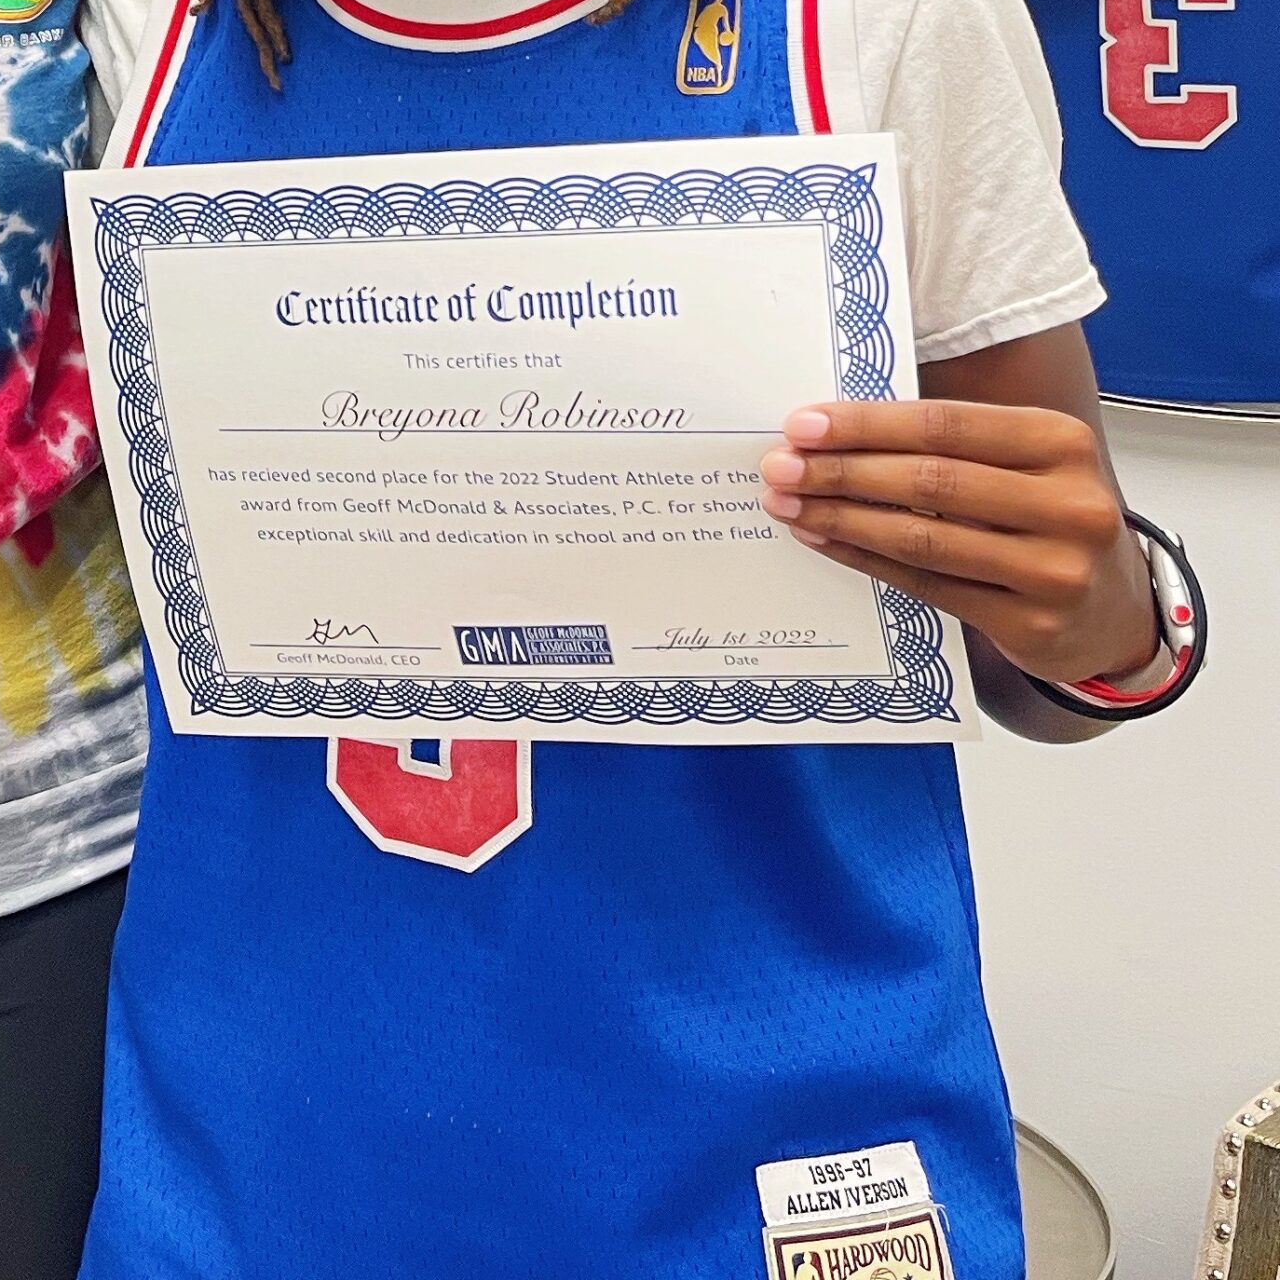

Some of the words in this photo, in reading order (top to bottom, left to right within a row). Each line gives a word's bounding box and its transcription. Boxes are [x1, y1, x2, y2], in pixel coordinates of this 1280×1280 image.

[20, 28, 64, 46] BANK
[687, 65, 716, 82] NBA
[276, 285, 439, 326] Certificate
[447, 283, 476, 322] of
[487, 278, 679, 329] Completion
[404, 353, 440, 369] This
[446, 353, 518, 369] certifies
[525, 353, 562, 369] that
[322, 389, 485, 442] Breyona
[500, 389, 692, 430] Robinson
[208, 467, 237, 482] has
[242, 468, 311, 483] recieved
[316, 469, 376, 484] second
[383, 470, 427, 488] place
[433, 470, 458, 484] for
[465, 470, 494, 485] the
[501, 471, 540, 485] 2022
[545, 470, 619, 485] Student
[625, 470, 695, 485] Athlete
[701, 470, 720, 485] of
[728, 470, 760, 484] the
[240, 498, 292, 512] award
[297, 497, 338, 513] from
[343, 498, 392, 513] Geoff
[398, 498, 487, 515] McDonald
[493, 500, 507, 515] &
[514, 500, 617, 516] Associates,
[623, 500, 662, 514] P.C.
[669, 499, 696, 514] for
[703, 497, 761, 512] showi
[258, 527, 354, 545] exceptional
[359, 528, 395, 543] skill
[399, 529, 430, 543] and
[436, 529, 528, 544] dedication
[533, 530, 549, 544] in
[556, 529, 617, 544] school
[622, 529, 655, 543] and
[662, 530, 686, 542] on
[693, 527, 723, 541] the
[730, 526, 779, 540] field.
[460, 630, 527, 663] GMA
[656, 627, 712, 652] July
[722, 631, 748, 645] 1st
[755, 629, 816, 645] 2022
[277, 652, 313, 664] Geoff
[317, 652, 387, 666] McDonald,
[391, 654, 421, 666] CEO
[724, 654, 759, 666] Date
[808, 1157, 873, 1185] 1996-97
[787, 1188, 841, 1216] ALLEN
[843, 1177, 909, 1208] IVERSON
[825, 1233, 932, 1280] HARDWOOD
